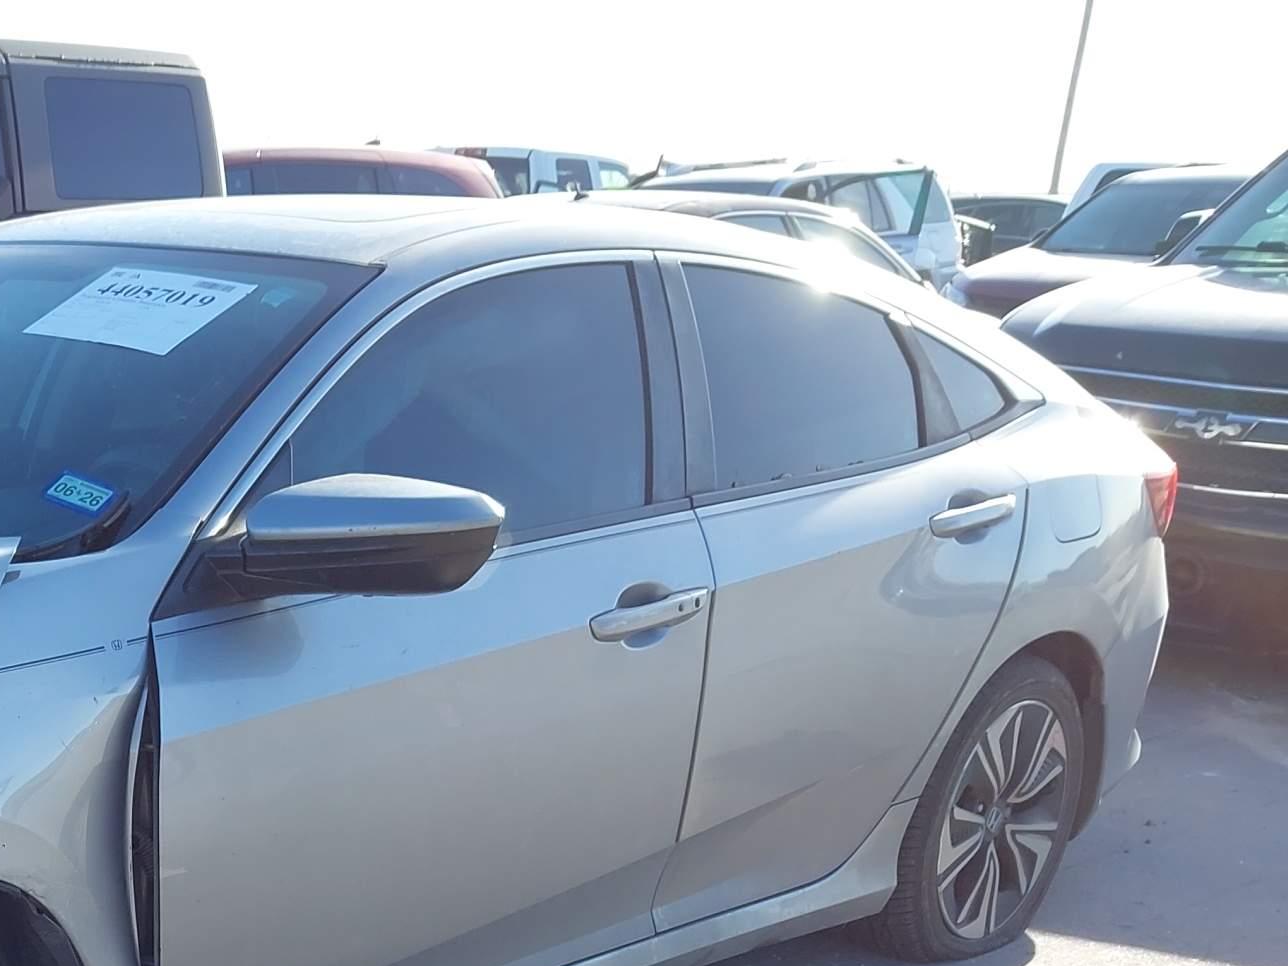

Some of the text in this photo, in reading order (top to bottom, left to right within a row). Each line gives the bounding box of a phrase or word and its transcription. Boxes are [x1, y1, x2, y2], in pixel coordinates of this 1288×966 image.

[96, 282, 217, 309] 44057019
[53, 481, 78, 497] 06
[78, 491, 104, 507] 26
